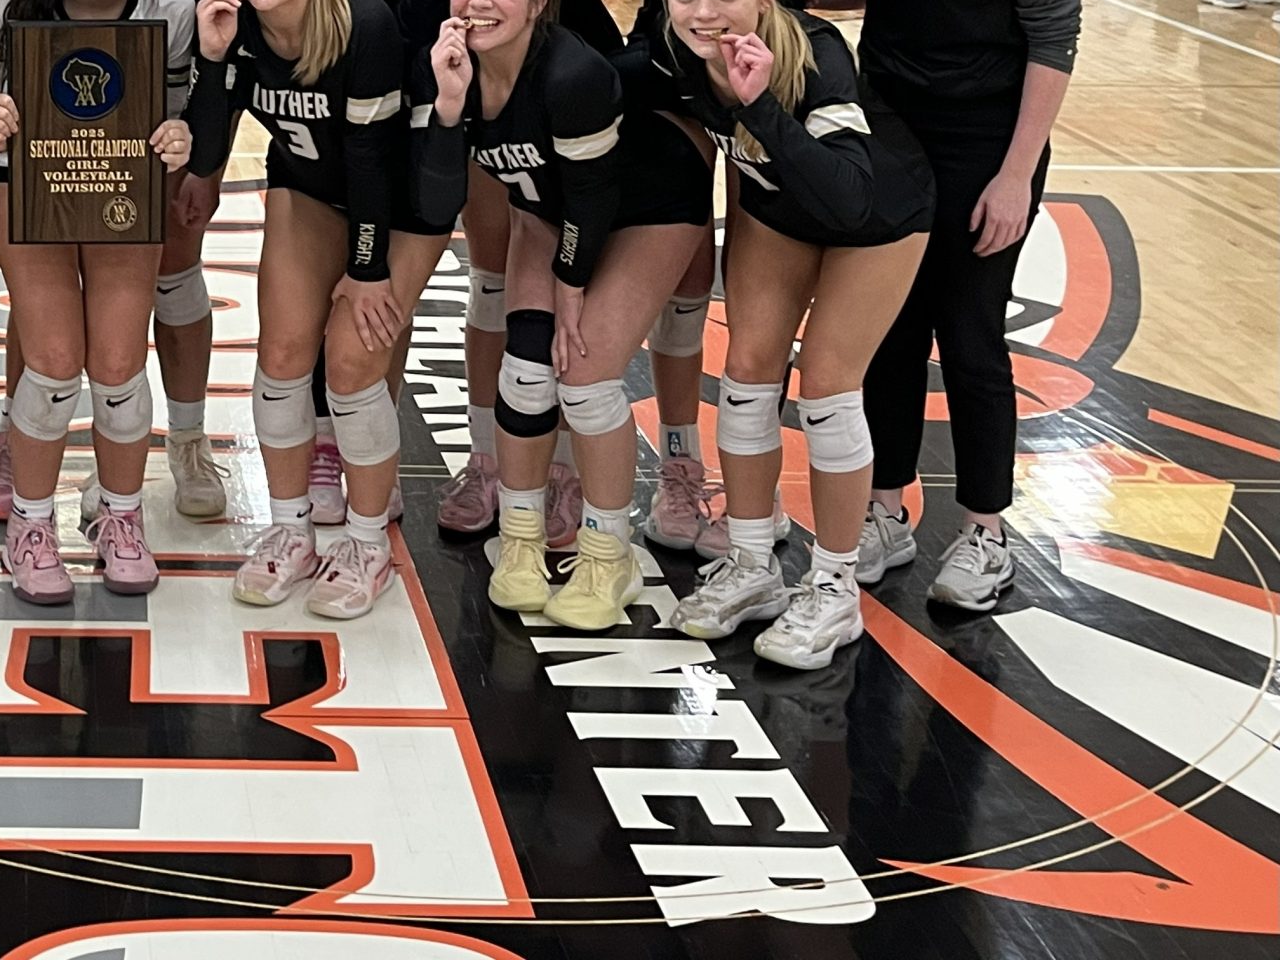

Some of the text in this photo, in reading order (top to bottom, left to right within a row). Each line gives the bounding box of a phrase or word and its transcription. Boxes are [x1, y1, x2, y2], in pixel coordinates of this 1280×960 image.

[252, 82, 332, 120] LUTHER
[71, 129, 104, 138] 2025
[275, 118, 320, 161] 3
[30, 140, 145, 158] SECTIONAL CHAMPION
[66, 160, 109, 170] GIRLS
[43, 171, 133, 181] VOLLEYBALL
[50, 183, 127, 193] DIVISION 3
[560, 219, 580, 268] KNIGHTS
